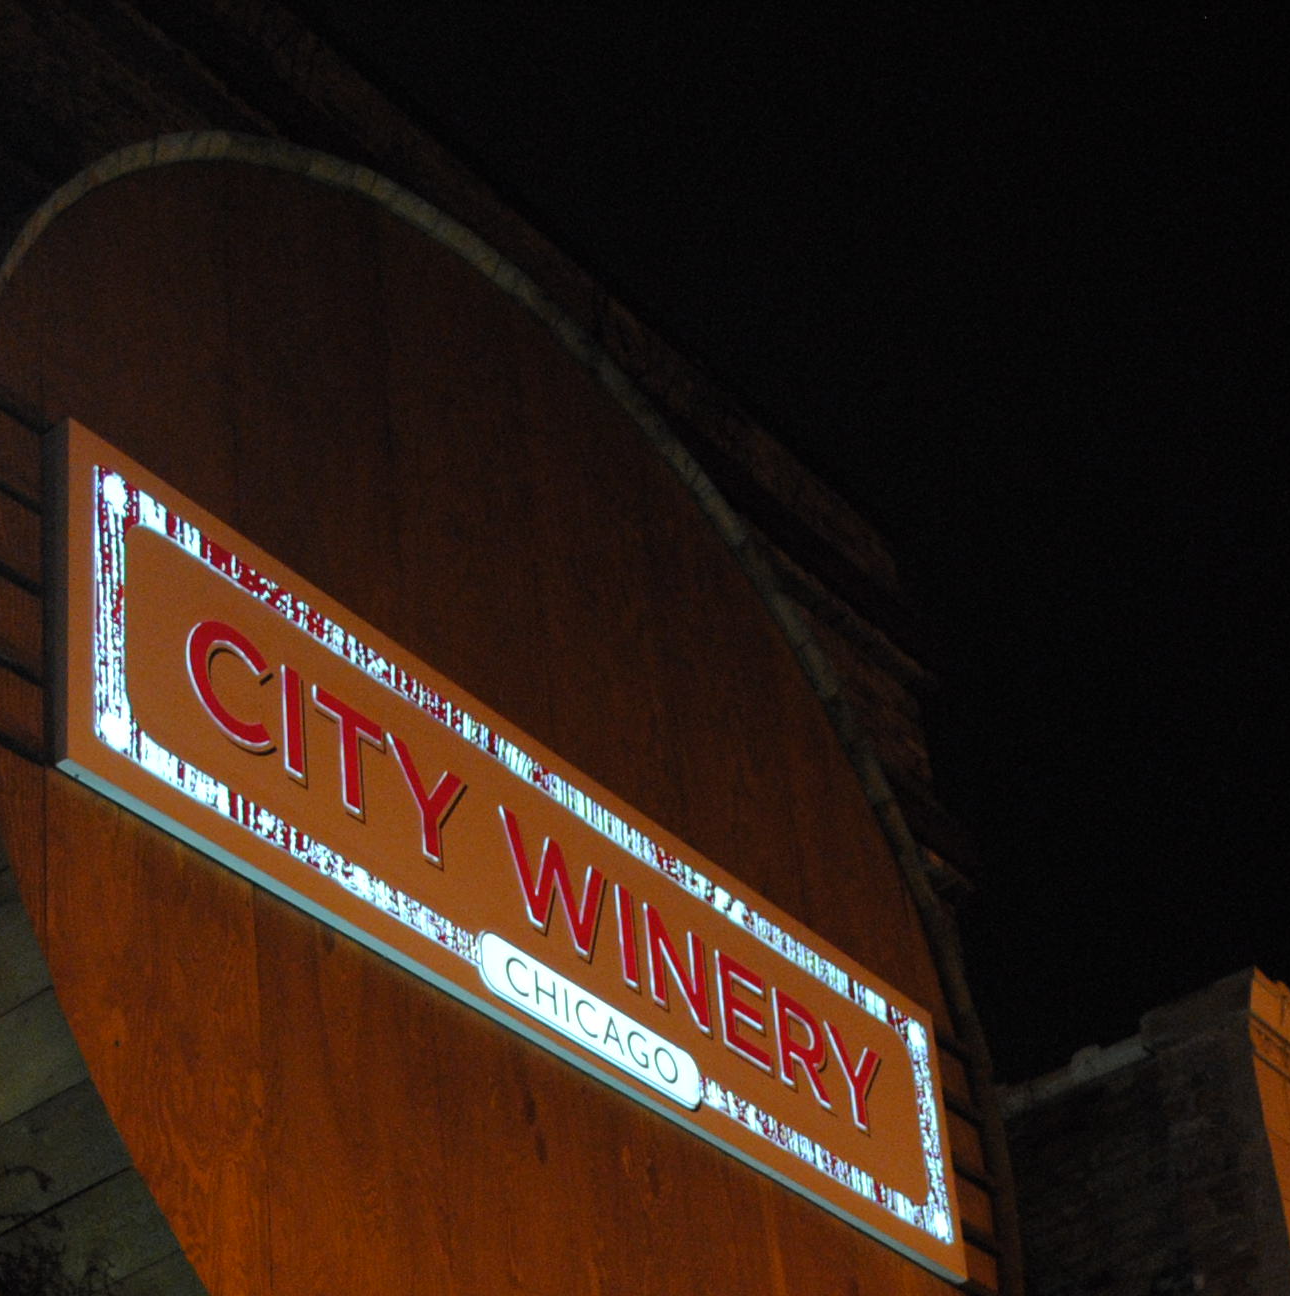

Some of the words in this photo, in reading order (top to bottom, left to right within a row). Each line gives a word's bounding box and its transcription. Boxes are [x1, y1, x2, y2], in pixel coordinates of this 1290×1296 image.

[185, 620, 463, 866] CITY
[499, 804, 878, 1131] WINERY
[506, 957, 679, 1084] CHICAGO
